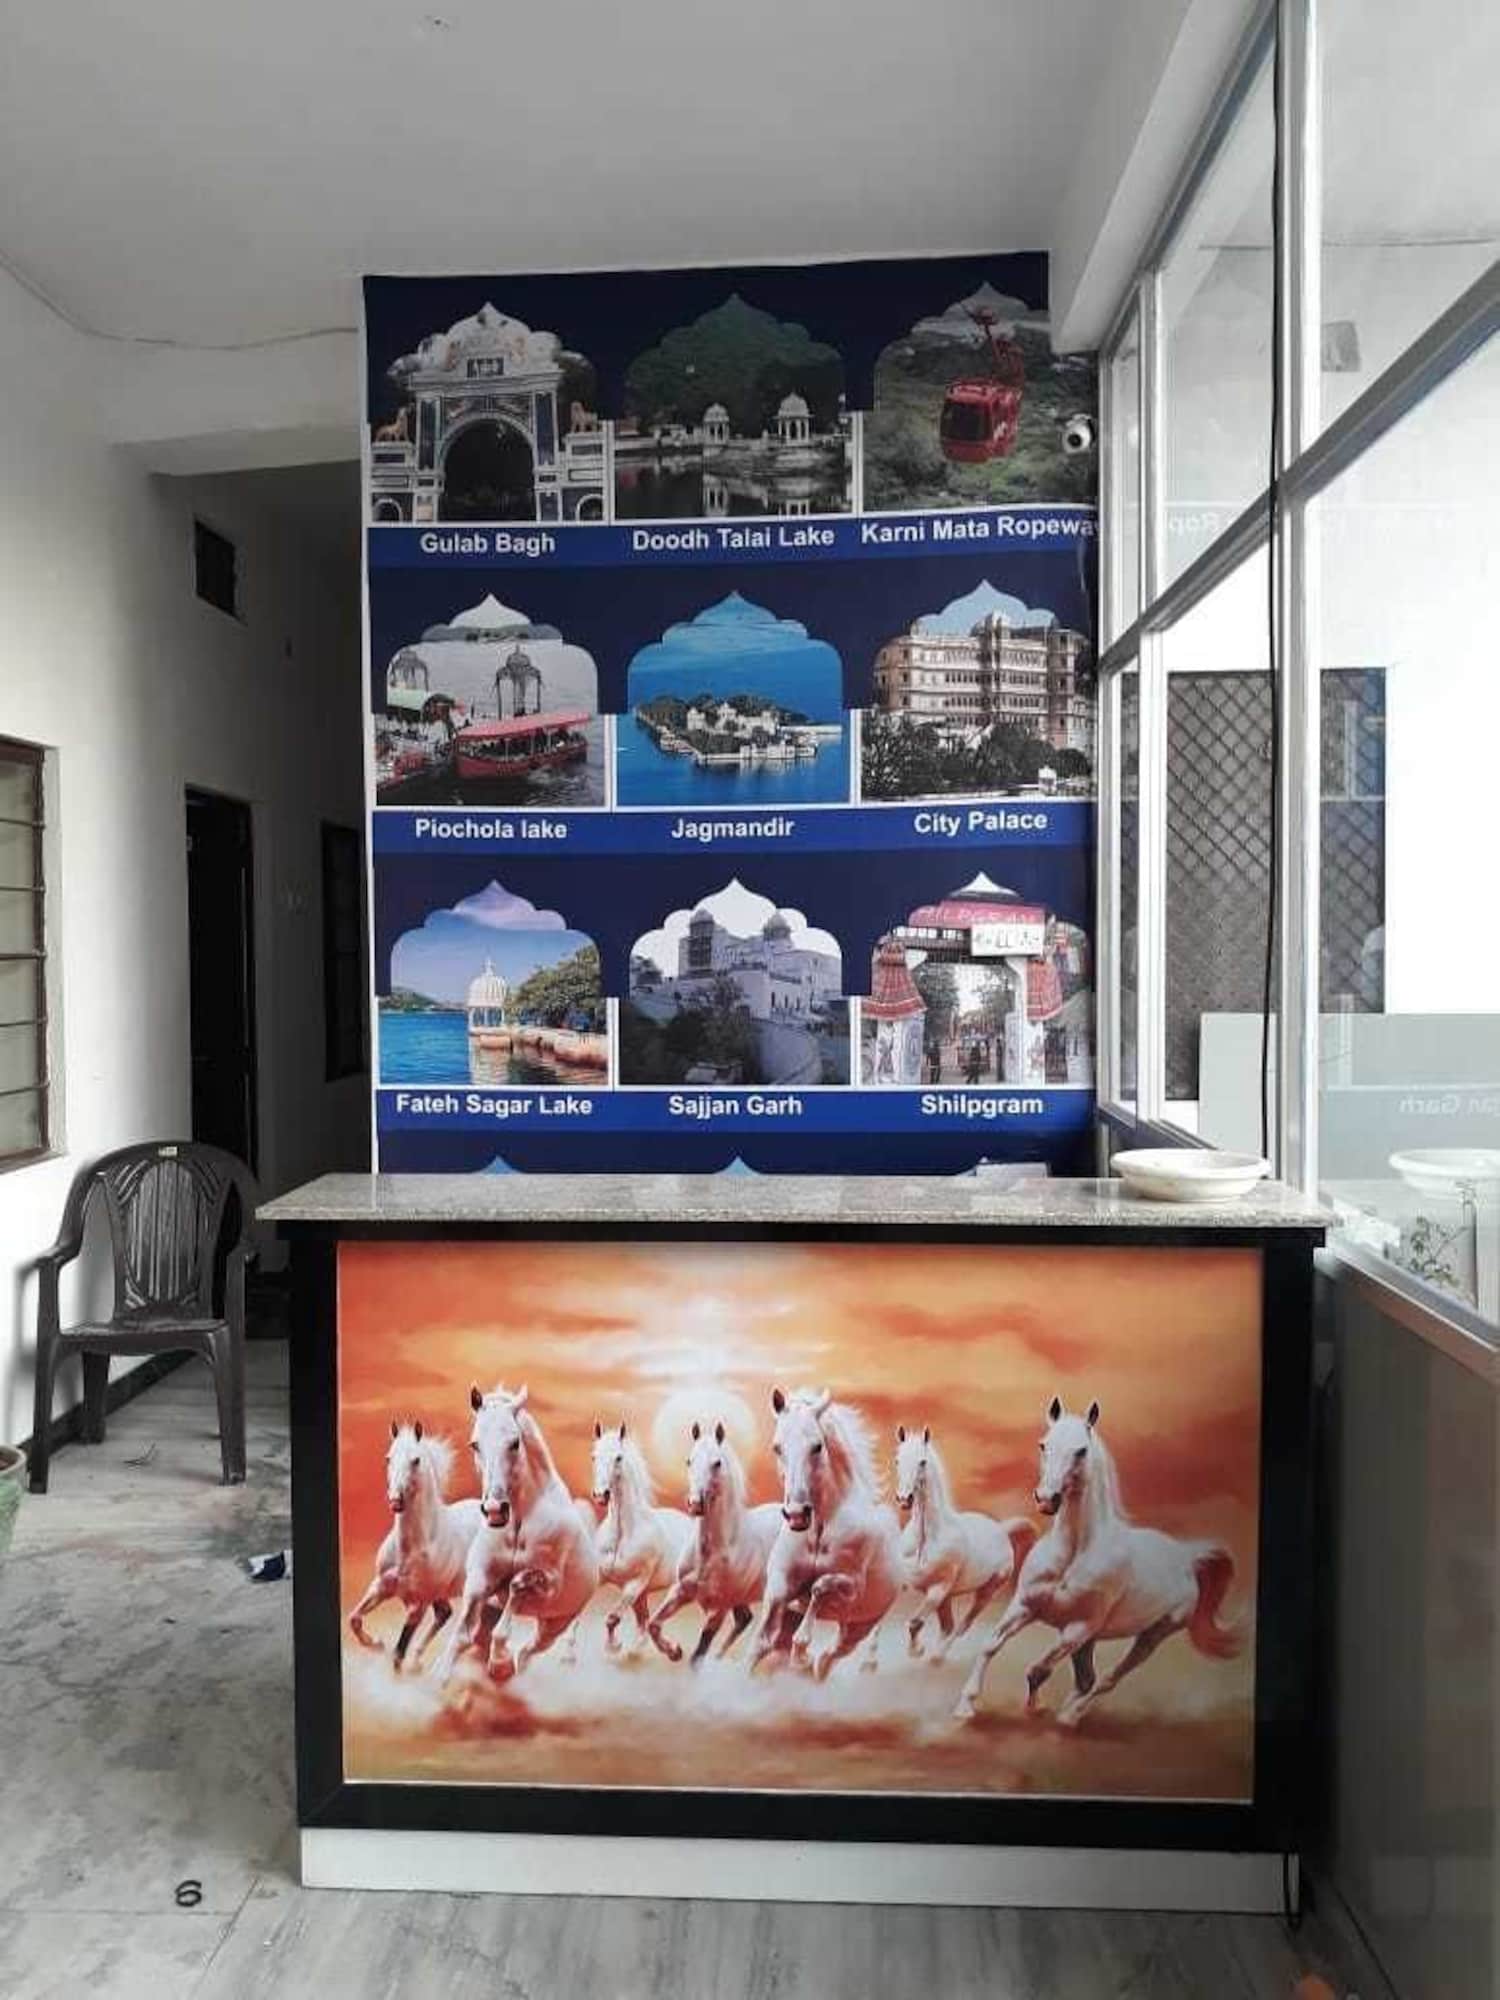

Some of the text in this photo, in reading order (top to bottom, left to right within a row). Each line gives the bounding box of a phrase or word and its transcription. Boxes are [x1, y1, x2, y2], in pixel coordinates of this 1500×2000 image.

[632, 526, 834, 550] Doodh Talai Lake
[861, 523, 925, 543] Karni
[932, 519, 989, 540] Mata
[420, 532, 556, 557] Gulab Bagh
[522, 818, 567, 838] lake
[672, 817, 794, 842] Jagmandir
[915, 810, 1047, 836] City Palace
[397, 1094, 592, 1118] Fateh Sagar Lake
[670, 1095, 802, 1119] Sajjan Garh
[922, 1095, 1043, 1118] Shilpgram
